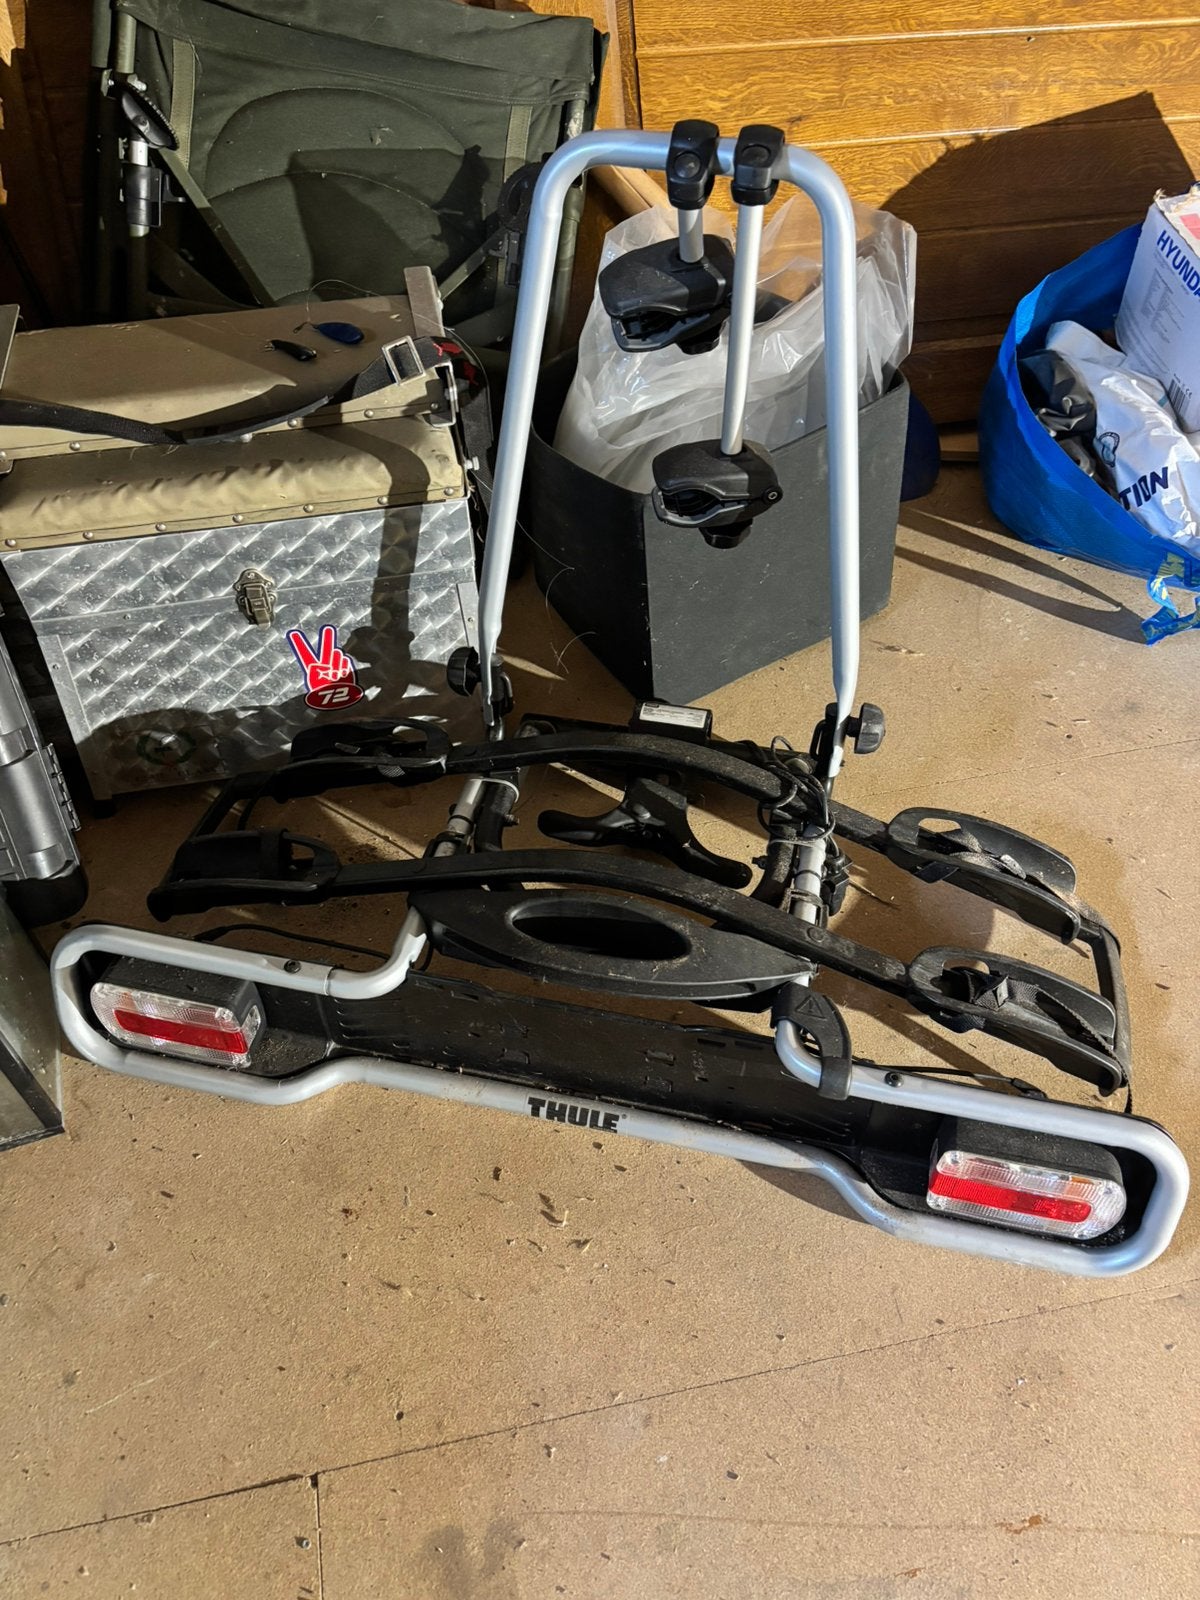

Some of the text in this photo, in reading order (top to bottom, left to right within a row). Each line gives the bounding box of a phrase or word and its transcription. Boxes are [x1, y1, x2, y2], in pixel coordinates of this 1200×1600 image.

[1118, 466, 1169, 511] TION
[318, 687, 350, 705] 72
[527, 1096, 620, 1134] THULE
